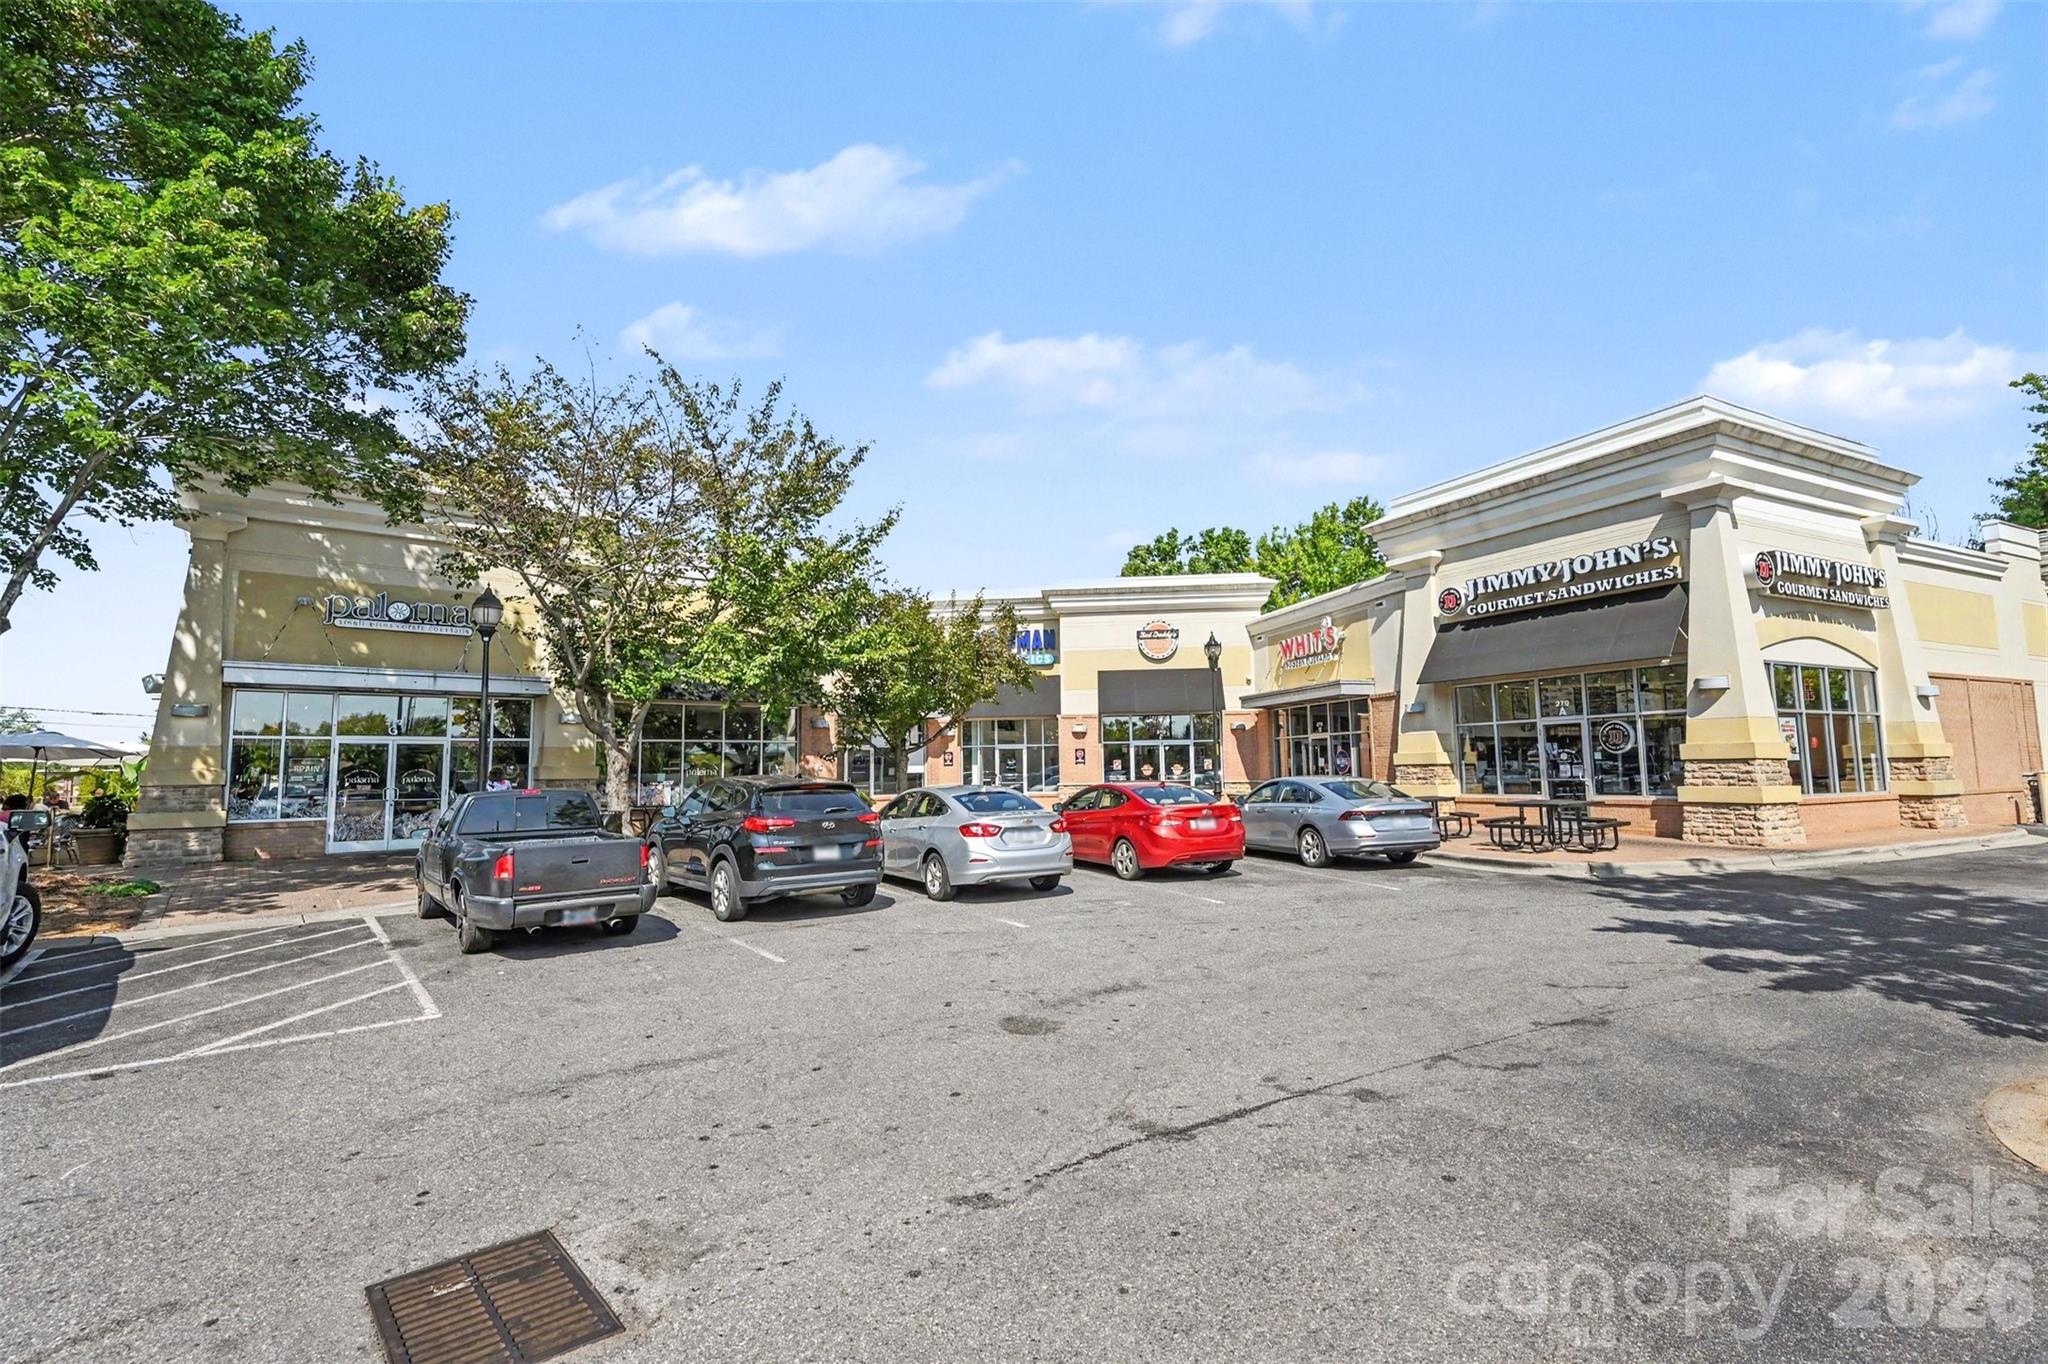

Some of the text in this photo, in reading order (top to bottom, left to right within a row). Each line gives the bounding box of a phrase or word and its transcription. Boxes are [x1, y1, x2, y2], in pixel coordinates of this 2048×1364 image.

[1466, 537, 1670, 600] JIMMY JOHN'S
[1775, 551, 1887, 588] JIMMY JOHN'S
[323, 591, 472, 627] paloma
[1467, 566, 1675, 616] GOURMET SANDWICHES
[1777, 581, 1890, 609] GOURMET SANDWICHES
[1280, 625, 1337, 661] WHIT'S
[1558, 706, 1567, 716] A
